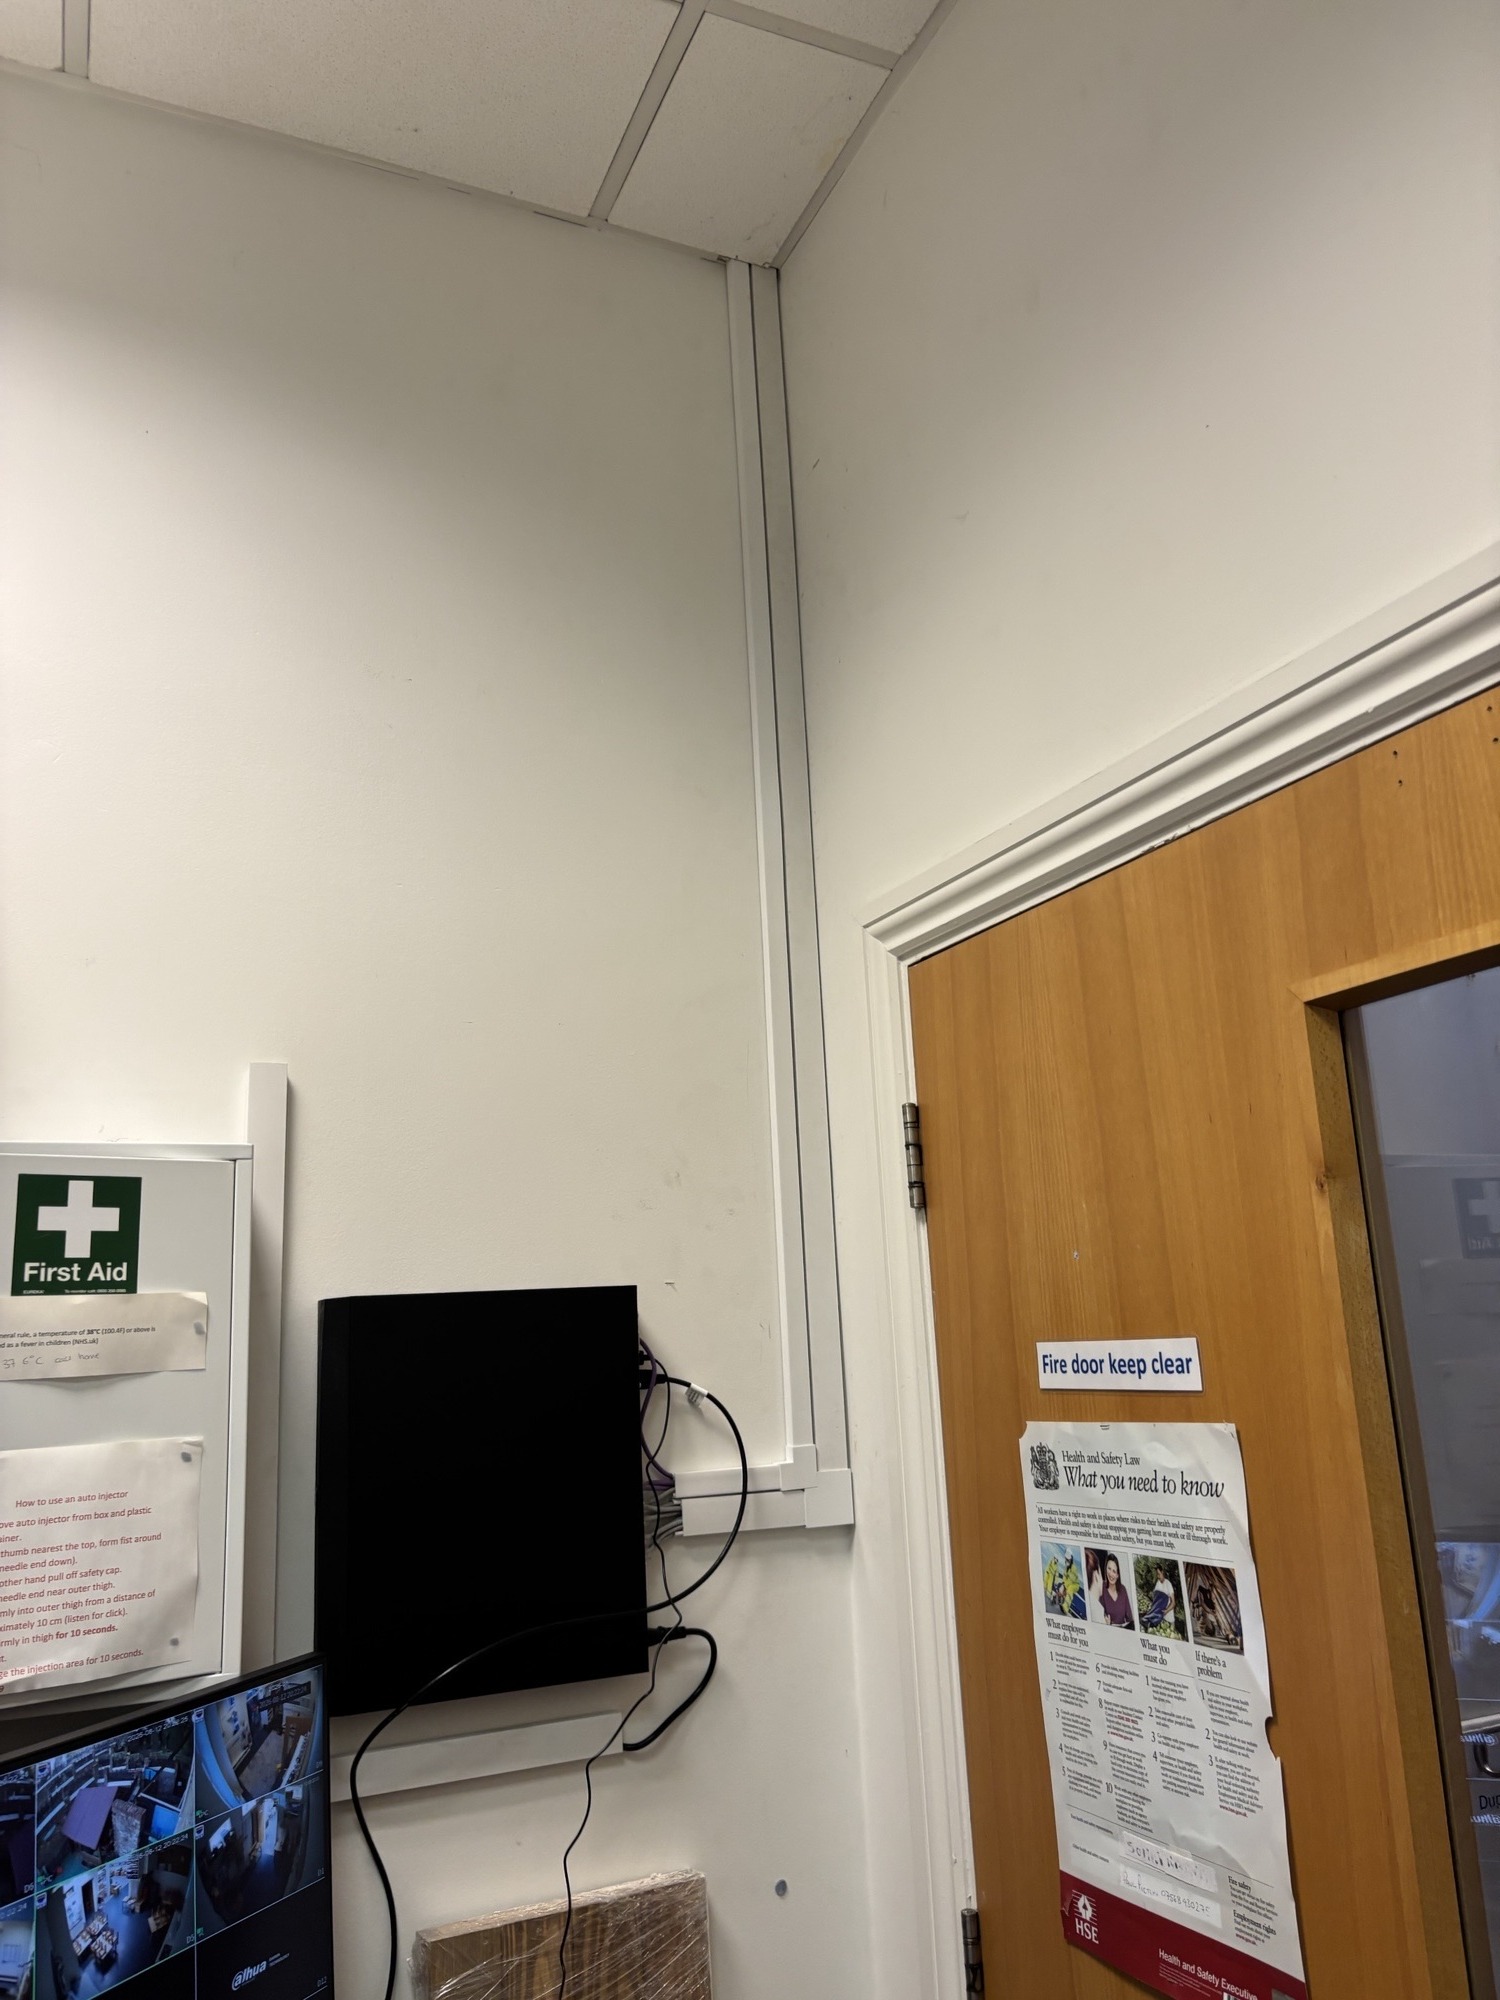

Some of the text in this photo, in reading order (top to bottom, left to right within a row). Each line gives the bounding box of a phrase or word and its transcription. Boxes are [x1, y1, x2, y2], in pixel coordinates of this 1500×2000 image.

[23, 1262, 128, 1283] First Aid
[38, 1330, 78, 1338] temperature
[1042, 1352, 1192, 1379] Fire door keep clear
[1062, 1450, 1140, 1468] Health and Safety Law
[1063, 1465, 1224, 1498] What you need to know
[16, 1500, 35, 1508] How
[49, 1497, 63, 1505] use
[78, 1494, 96, 1502] auto
[98, 1491, 128, 1501] injector
[0, 1507, 151, 1529] ove auto injector from box and plastic
[1, 1533, 162, 1558] thumb nearest the top, form fist around
[0, 1556, 77, 1572] needle end down).
[0, 1567, 122, 1588] other hand pull off safety cap.
[28, 1589, 45, 1598] end
[47, 1588, 65, 1596] near
[68, 1585, 91, 1594] outer
[93, 1582, 115, 1591] thigh.
[18, 1607, 34, 1615] into
[37, 1604, 60, 1613] outer
[62, 1600, 83, 1610] thigh
[85, 1598, 105, 1606] from
[113, 1592, 146, 1602] distance
[148, 1589, 156, 1597] of
[37, 1618, 48, 1627] 10
[50, 1617, 62, 1626] cm
[64, 1614, 89, 1625] (listen
[106, 1607, 128, 1618] click).
[1046, 1618, 1086, 1636] What employers
[0, 1624, 118, 1647] rmly in thigh for 10 seconds.
[1048, 1632, 1089, 1647] must do for you
[1140, 1638, 1170, 1655] What you
[11, 1667, 25, 1676] the
[27, 1661, 64, 1674] injection
[66, 1658, 84, 1668] area
[86, 1656, 98, 1664] for
[100, 1654, 110, 1663] 10
[111, 1649, 144, 1661] seconds.
[1143, 1653, 1167, 1666] must do
[1195, 1650, 1200, 1661] If
[1202, 1653, 1221, 1666] there's
[1096, 1663, 1100, 1672] 6
[1197, 1666, 1223, 1680] problem
[1053, 1679, 1057, 1689] 2
[1097, 1680, 1101, 1690] 7
[1098, 1698, 1103, 1708] 8
[1056, 1708, 1059, 1718] 3
[1148, 1706, 1154, 1717] 2
[1151, 1732, 1156, 1742] 3
[1205, 1728, 1210, 1740] 2
[1059, 1743, 1063, 1752] 4
[1103, 1740, 1107, 1750] 9
[1153, 1751, 1157, 1761] 4
[1209, 1755, 1213, 1766] 3
[1106, 1782, 1113, 1793] 10
[1228, 1875, 1251, 1893] Fire safety
[1075, 1918, 1099, 1944] HSE
[1233, 1910, 1262, 1929] Employment
[1263, 1923, 1276, 1936] rights
[1159, 1948, 1181, 1967] Health
[1182, 1960, 1195, 1974] and
[1197, 1966, 1219, 1987] Safety
[1221, 1978, 1258, 2000] Executive
